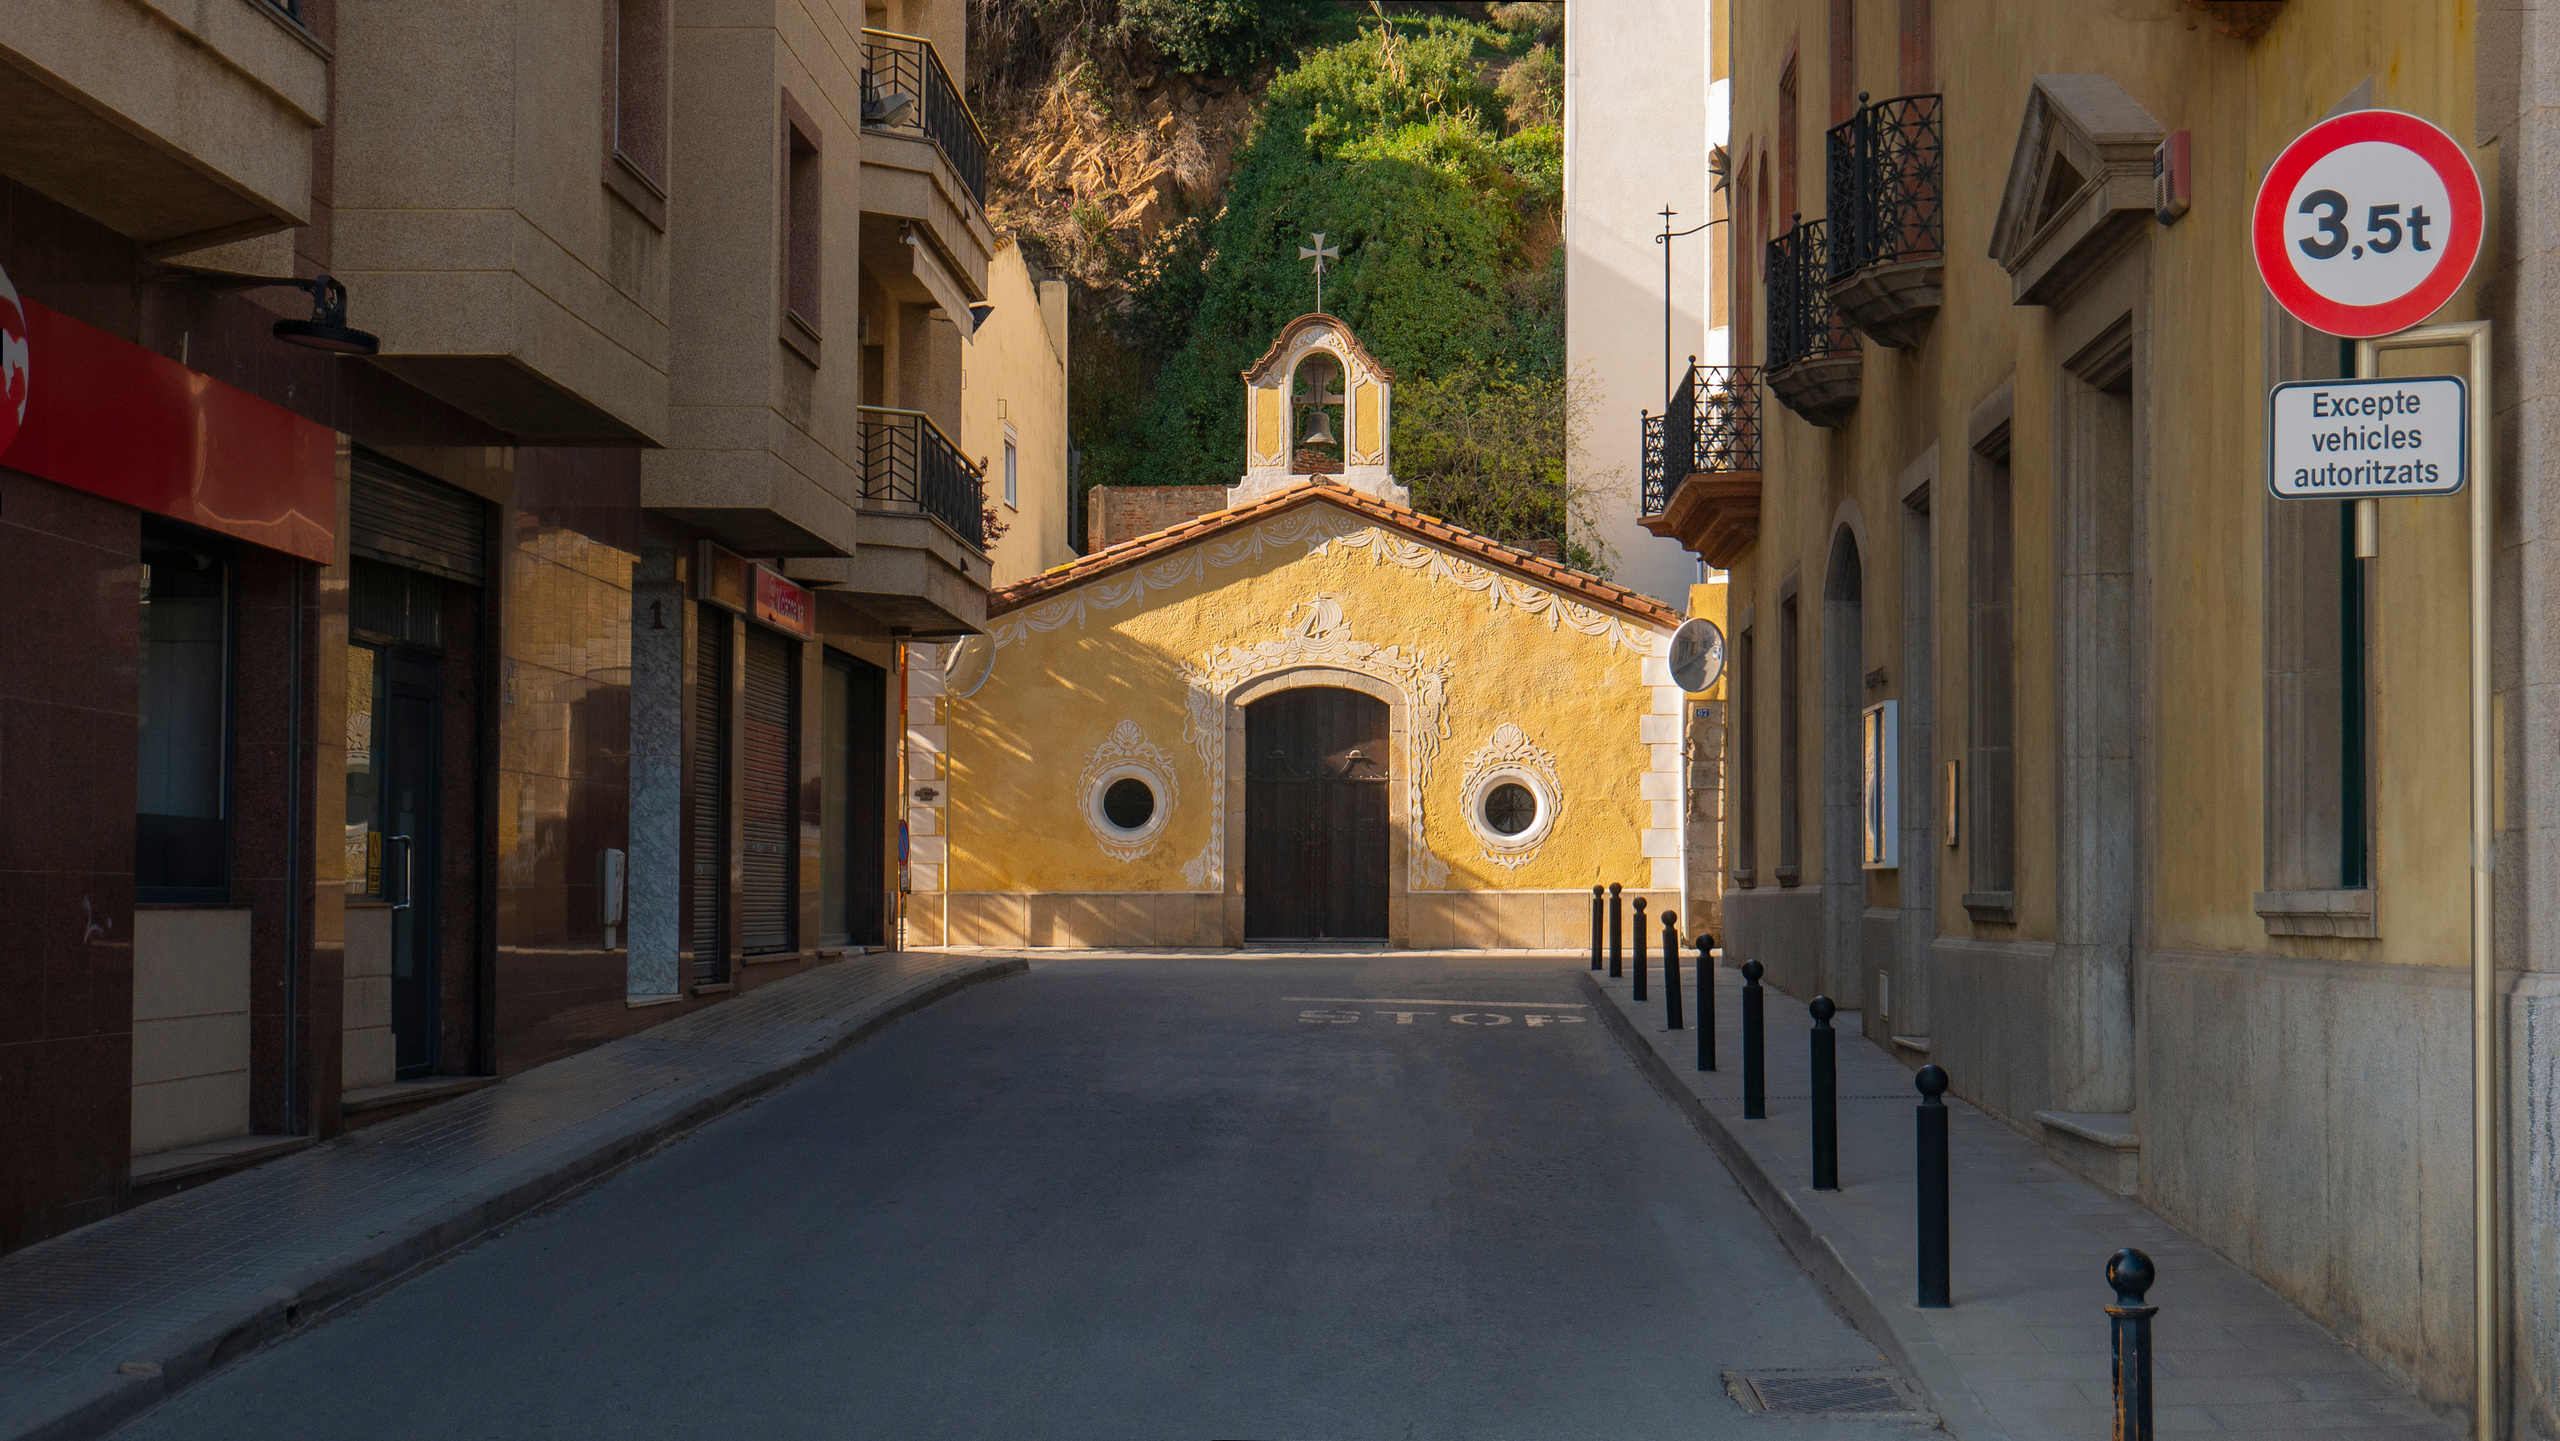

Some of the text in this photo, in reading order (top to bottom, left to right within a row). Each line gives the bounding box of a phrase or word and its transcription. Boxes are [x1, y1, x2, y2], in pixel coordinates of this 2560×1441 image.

[2298, 189, 2432, 260] 3,5t
[2313, 390, 2421, 421] Excepte
[2312, 424, 2422, 452] vehicles
[2294, 459, 2439, 487] autoritzats
[650, 600, 664, 630] 1
[1298, 1009, 1587, 1027] STOP
